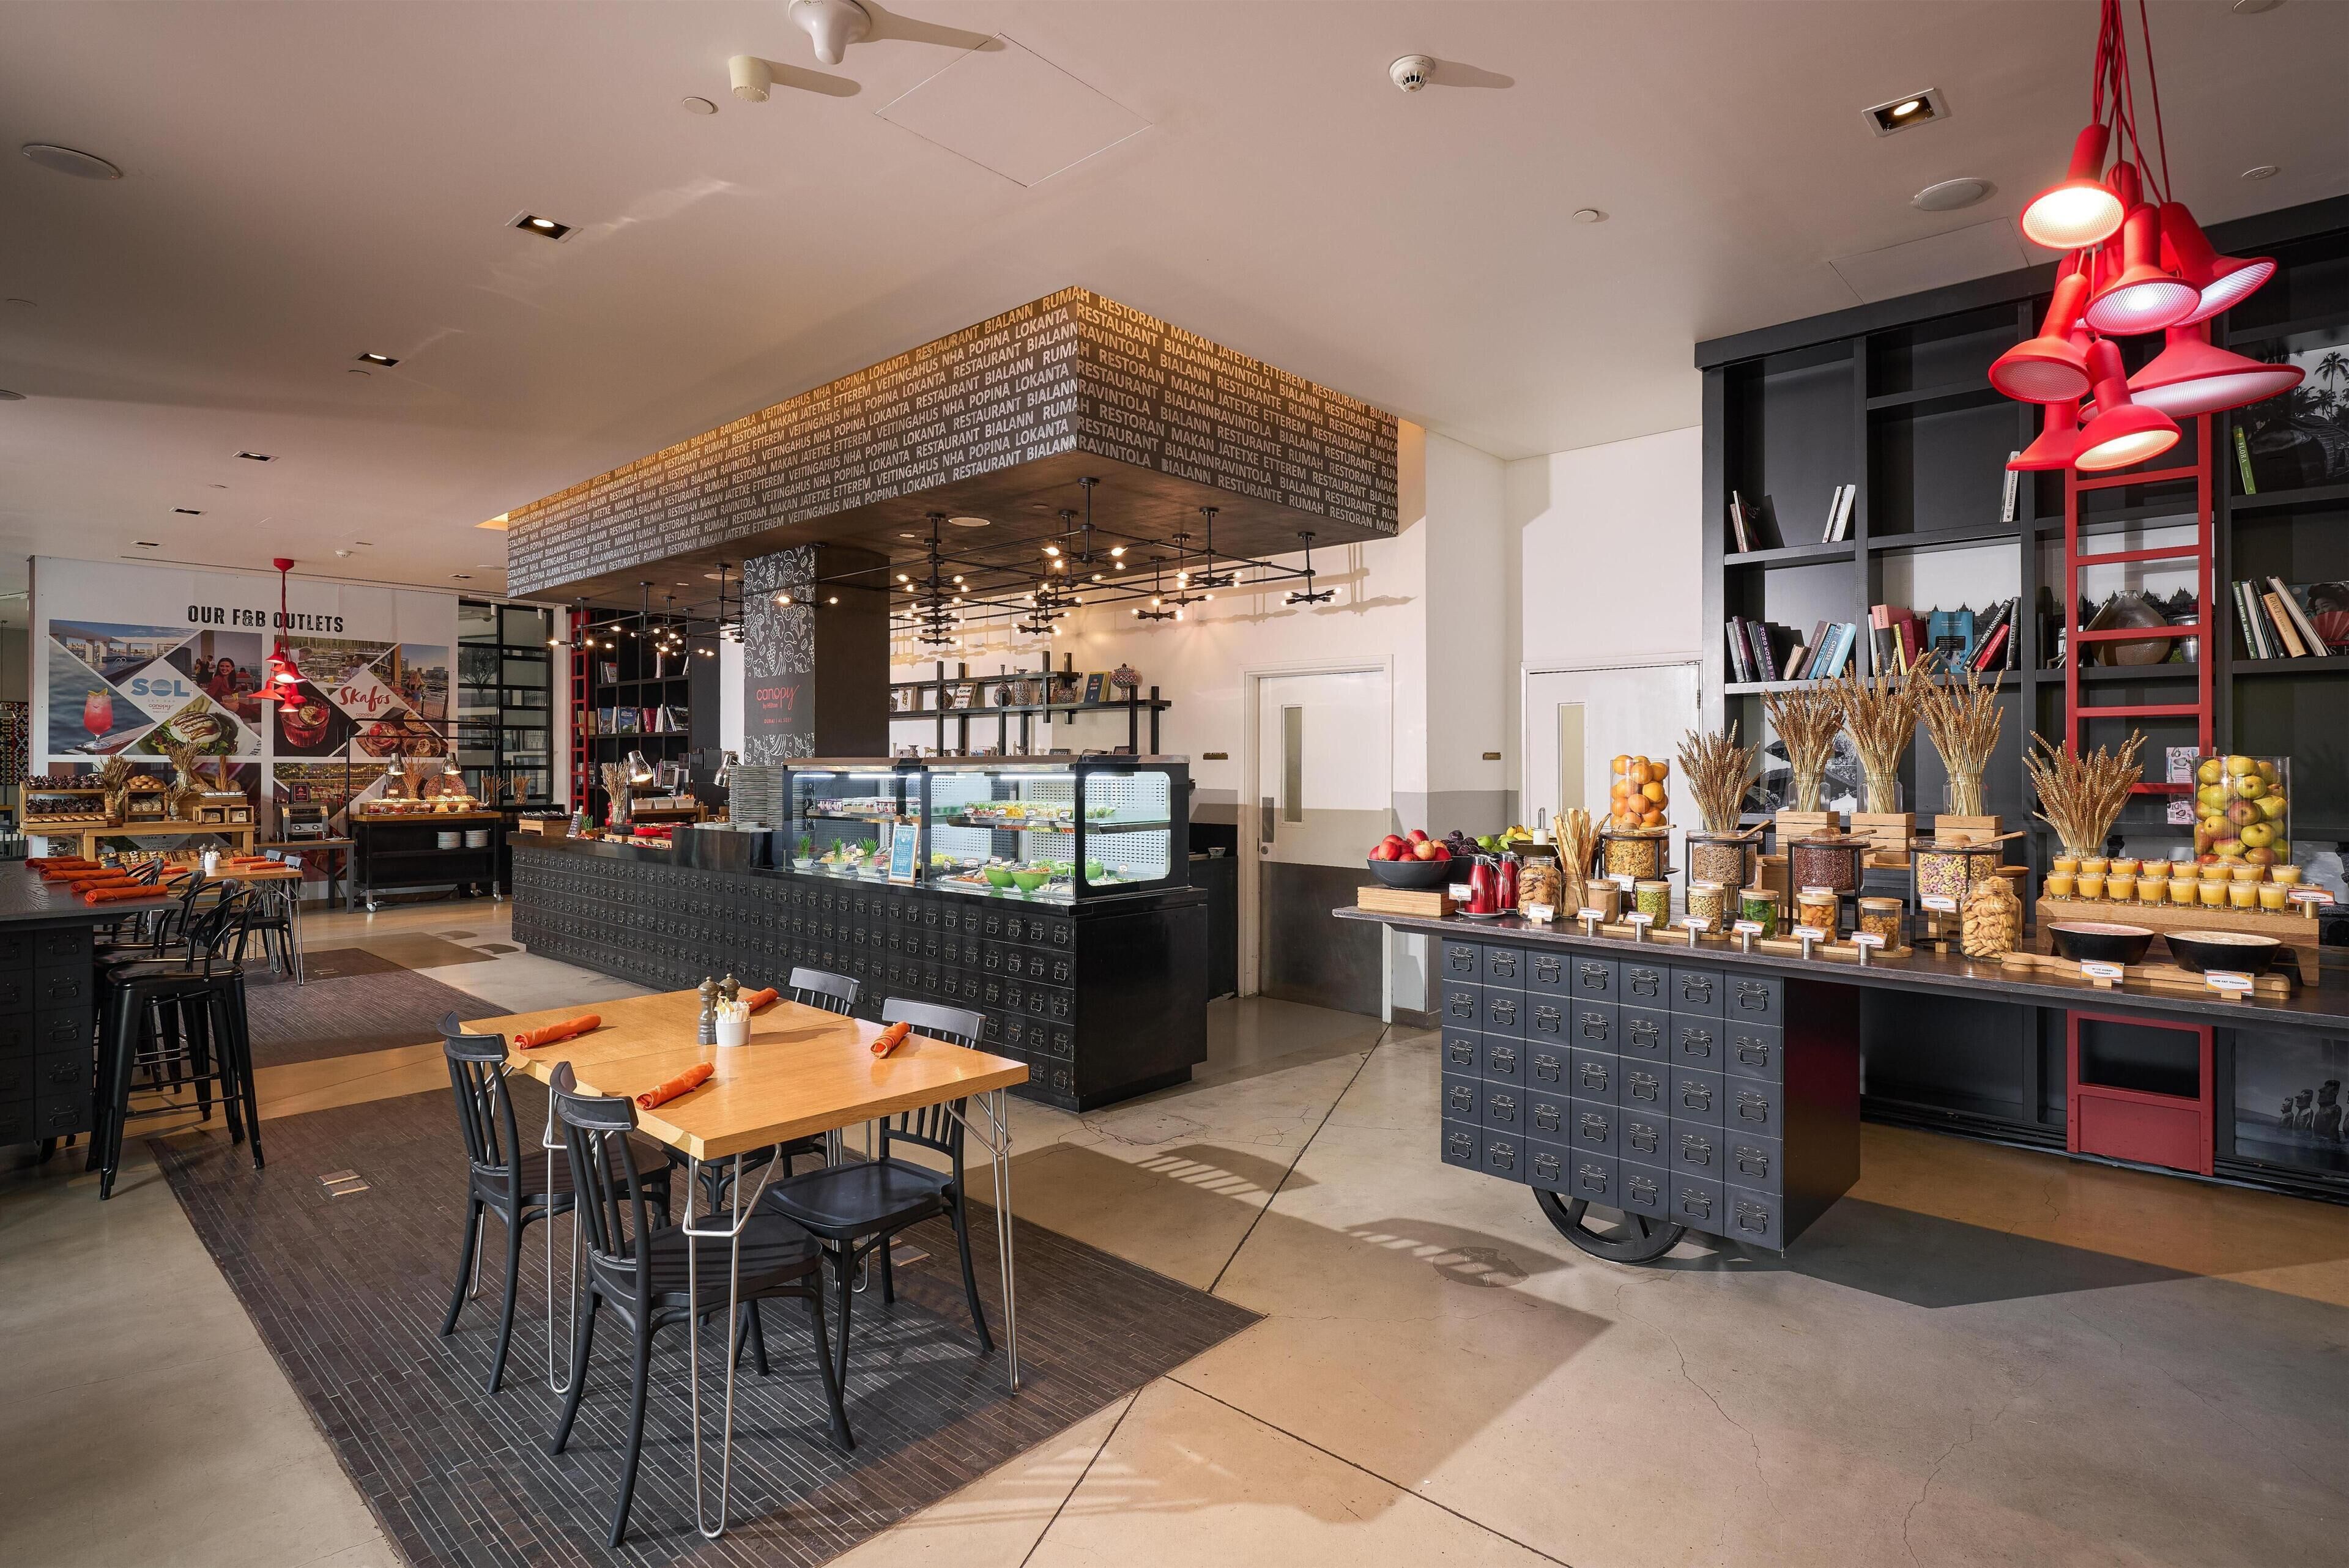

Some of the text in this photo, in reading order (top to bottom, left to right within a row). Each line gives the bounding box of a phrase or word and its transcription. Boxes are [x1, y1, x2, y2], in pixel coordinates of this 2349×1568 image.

[834, 371, 864, 393] POPINA
[869, 352, 909, 380] LOKANTA
[916, 325, 979, 361] RESTAURANT
[985, 303, 1033, 335] BIALANN
[834, 306, 1068, 407] ETTEREM VEITINGAHUS NHA POPINA LOKANTA
[844, 321, 1077, 419] NHA POPINA LOKANTA RESTAURANT BIALANN
[1077, 303, 1157, 347] RESTAURANT
[1280, 383, 1319, 410] BIALANN
[1325, 401, 1376, 432] RESTURANTE
[1078, 322, 1371, 444] RAVINTOLA BIALANN RESTURANTE RUMAH RESTORAN
[1099, 295, 1365, 415] RESTORAN MAKAN JATETXE ETTEREM RESTAURANT
[592, 505, 610, 520] JATETXE
[615, 497, 633, 512] MAKAN
[636, 489, 655, 505] RUMAH
[659, 478, 687, 497] RESTORAN
[691, 468, 716, 486] BIALANN
[720, 454, 755, 476] RAVINTOLA
[762, 435, 810, 462] VEITINGAHUS
[814, 427, 830, 444] NHA
[834, 415, 864, 437] POPINA
[869, 399, 909, 426] LOKANTA
[916, 375, 979, 409] RESTAURANT
[985, 356, 1033, 386] BIALANN
[834, 362, 1068, 453] ETTEREM VEITINGAHUS NHA POPINA LOKANTA
[834, 462, 864, 483] POPINA
[869, 448, 909, 472] LOKANTA
[916, 427, 979, 459] RESTAURANT
[985, 411, 1033, 438] BIALANN
[844, 378, 1077, 465] NHA POPINA LOKANTA RESTAURANT BIALANN
[1077, 359, 1157, 400] RESTAURANT
[1280, 430, 1319, 454] BIALANN
[1325, 446, 1376, 473] RESTURANTE
[1078, 379, 1371, 486] RAVINTOLA BIALANN RESTURANTE RUMAH RESTORAN
[1099, 348, 1365, 456] RESTORAN MAKAN JATETXE ETTEREM RESTAURANT
[834, 418, 1068, 497] ETTEREM VEITINGAHUS NHA POPINA LOKANTA
[844, 435, 1077, 510] NHA POPINA LOKANTA RESTAURANT BIALANN
[1077, 415, 1157, 453] RESTAURANT
[1280, 476, 1319, 499] BIALANN
[1325, 490, 1376, 516] RESTURANTE
[1078, 434, 1371, 528] RAVINTOLA BIALANN RESTURANTE RUMAH RESTORAN
[1099, 404, 1365, 498] RESTORAN MAKAN JATETXE ETTEREM RESTAURANT
[2238, 442, 2247, 463] FLORA
[188, 605, 343, 632] OUR F&B OUTLETS
[1825, 640, 1836, 660] CHEESE
[1979, 629, 1992, 644] DEPP
[1988, 607, 2006, 631] JOHNNY
[131, 678, 190, 697] SOL
[339, 686, 391, 712] Skafos
[756, 685, 800, 710] canopy
